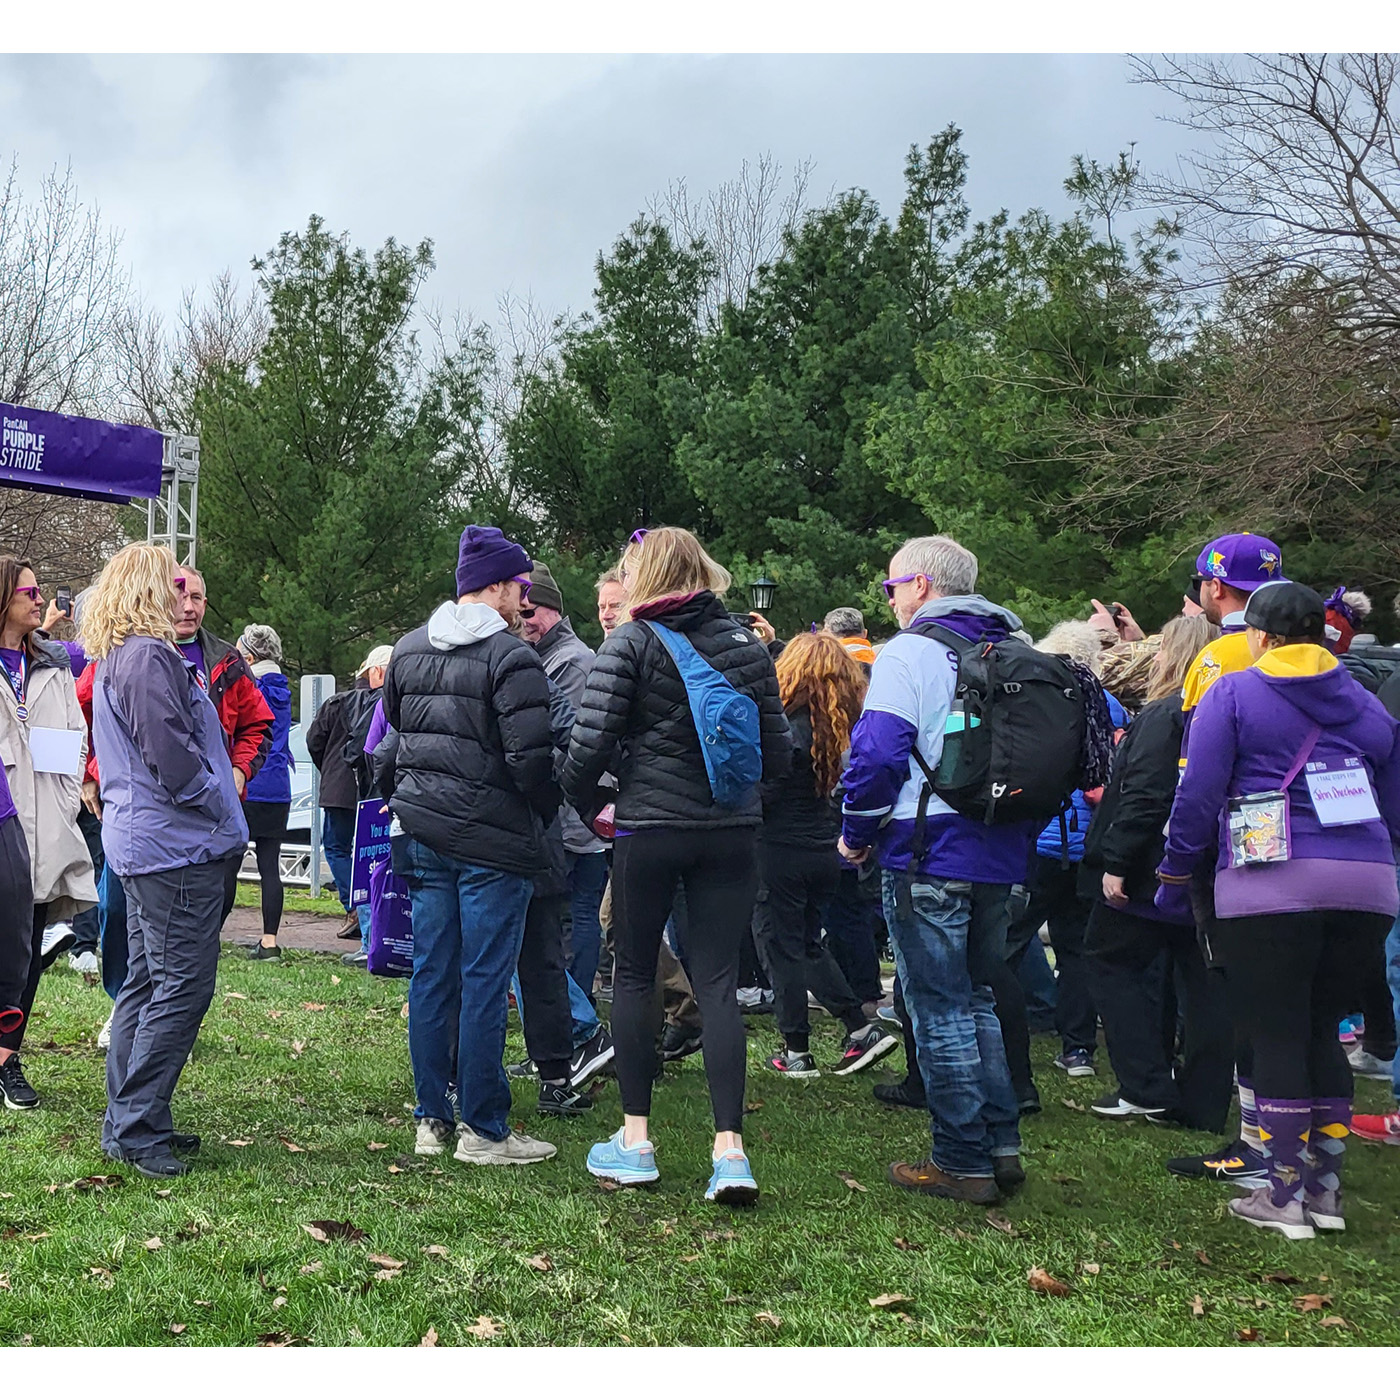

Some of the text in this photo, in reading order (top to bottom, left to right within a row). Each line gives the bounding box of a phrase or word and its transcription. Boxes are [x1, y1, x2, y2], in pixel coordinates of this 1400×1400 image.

[3, 416, 28, 431] PanCAN
[3, 428, 45, 451] PURPLE
[0, 447, 44, 471] STRIDE
[370, 823, 383, 839] You
